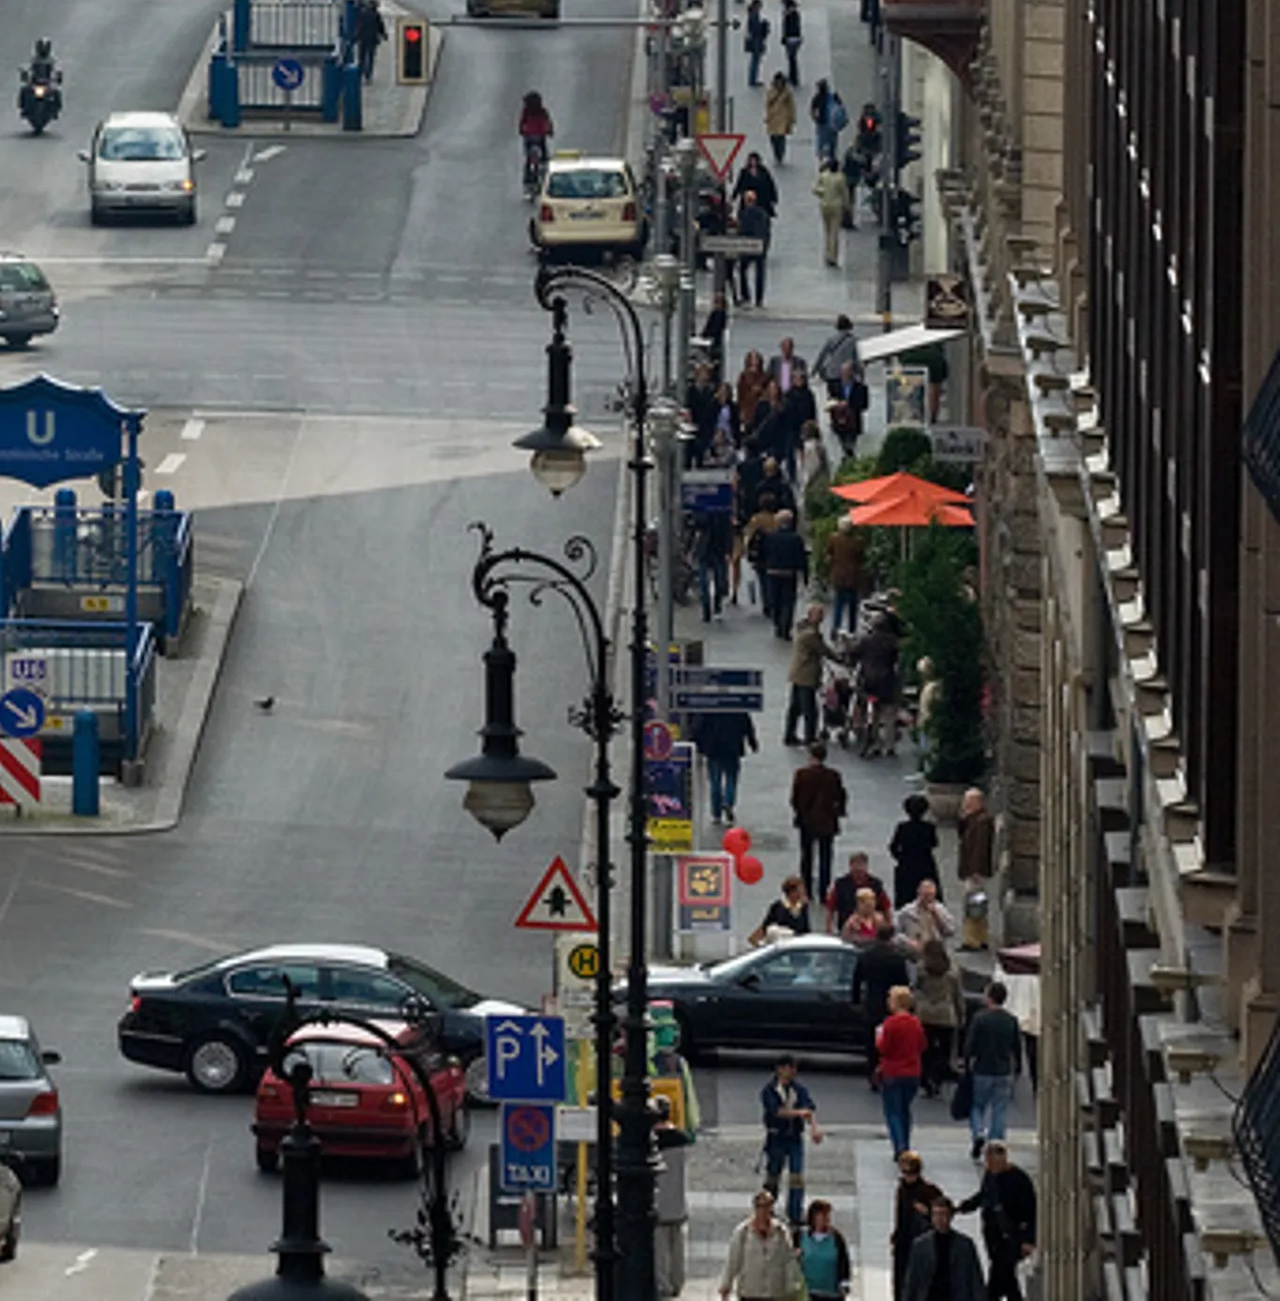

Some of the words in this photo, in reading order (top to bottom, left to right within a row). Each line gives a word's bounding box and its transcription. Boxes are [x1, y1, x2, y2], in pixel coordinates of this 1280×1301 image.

[26, 410, 55, 445] U
[578, 952, 595, 972] H
[496, 1035, 521, 1080] P
[507, 1164, 551, 1184] TAXI
